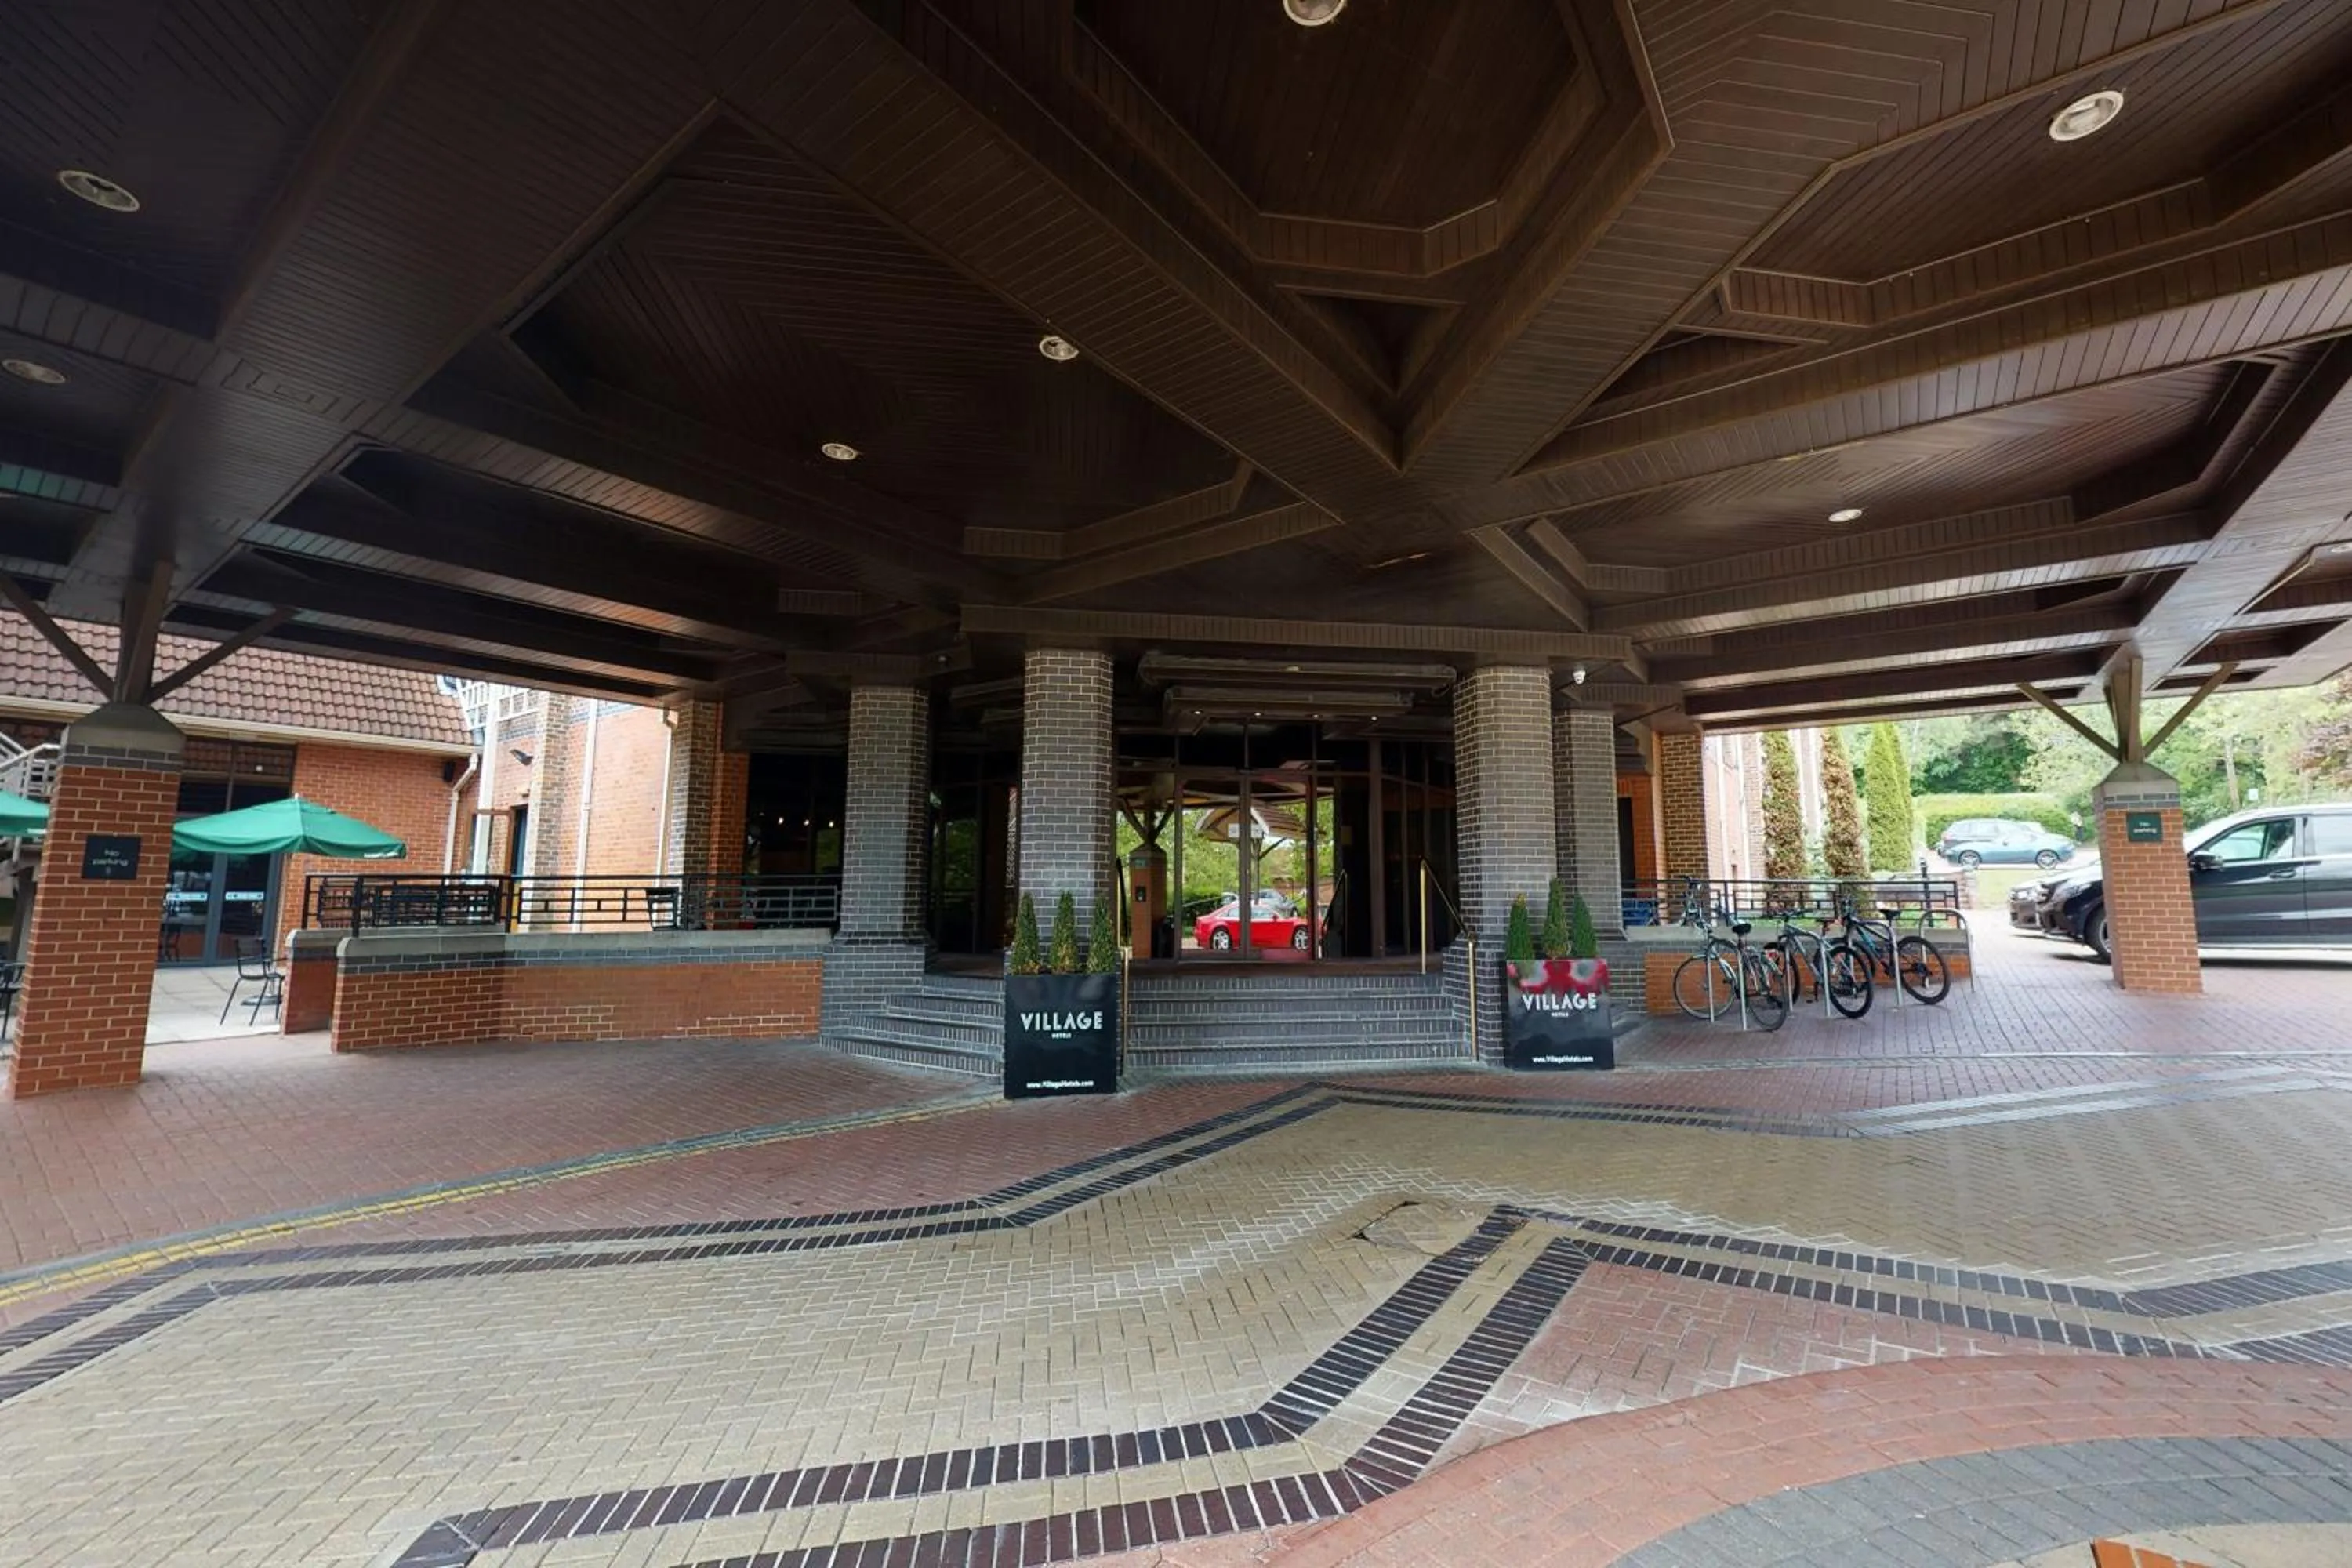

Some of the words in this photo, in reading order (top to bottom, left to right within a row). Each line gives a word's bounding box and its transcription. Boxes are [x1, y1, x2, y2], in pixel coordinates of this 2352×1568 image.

[92, 858, 129, 866] parking
[1522, 993, 1597, 1011] VILLAGE
[1020, 1011, 1103, 1032] VILLAGE
